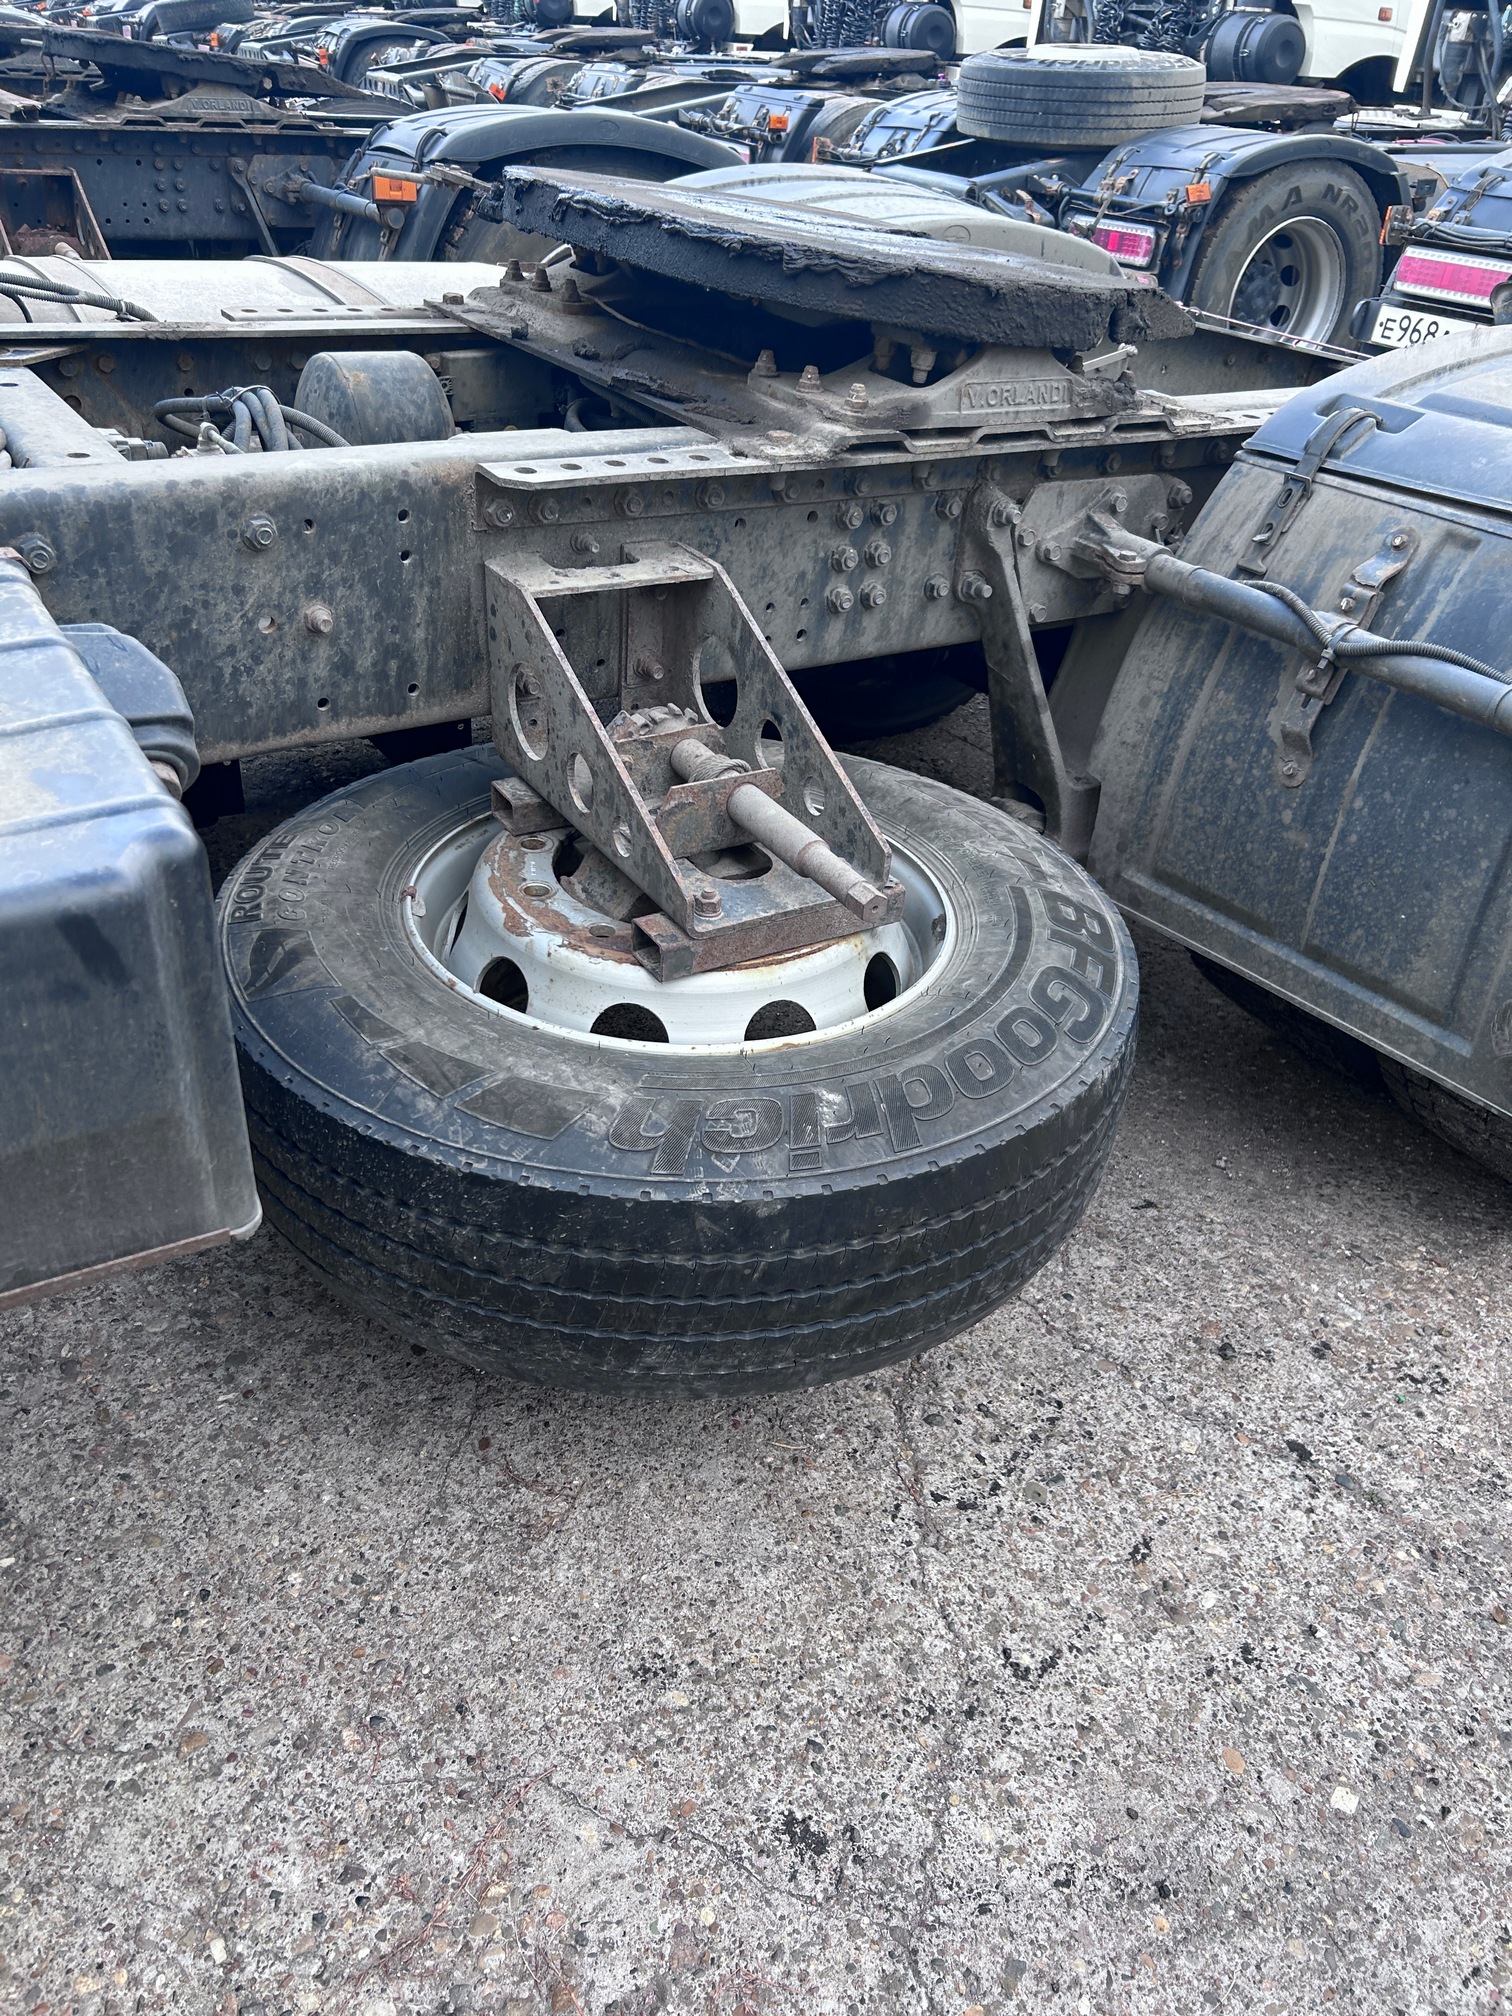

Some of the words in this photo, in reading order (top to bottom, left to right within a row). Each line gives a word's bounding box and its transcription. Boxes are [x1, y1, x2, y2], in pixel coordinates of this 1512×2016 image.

[1381, 315, 1450, 344] E968
[967, 382, 1067, 408] V.ORLANDI
[228, 834, 300, 926] ROUTE
[277, 810, 357, 921] CONTROL
[608, 888, 1117, 1176] BFGoodrich
